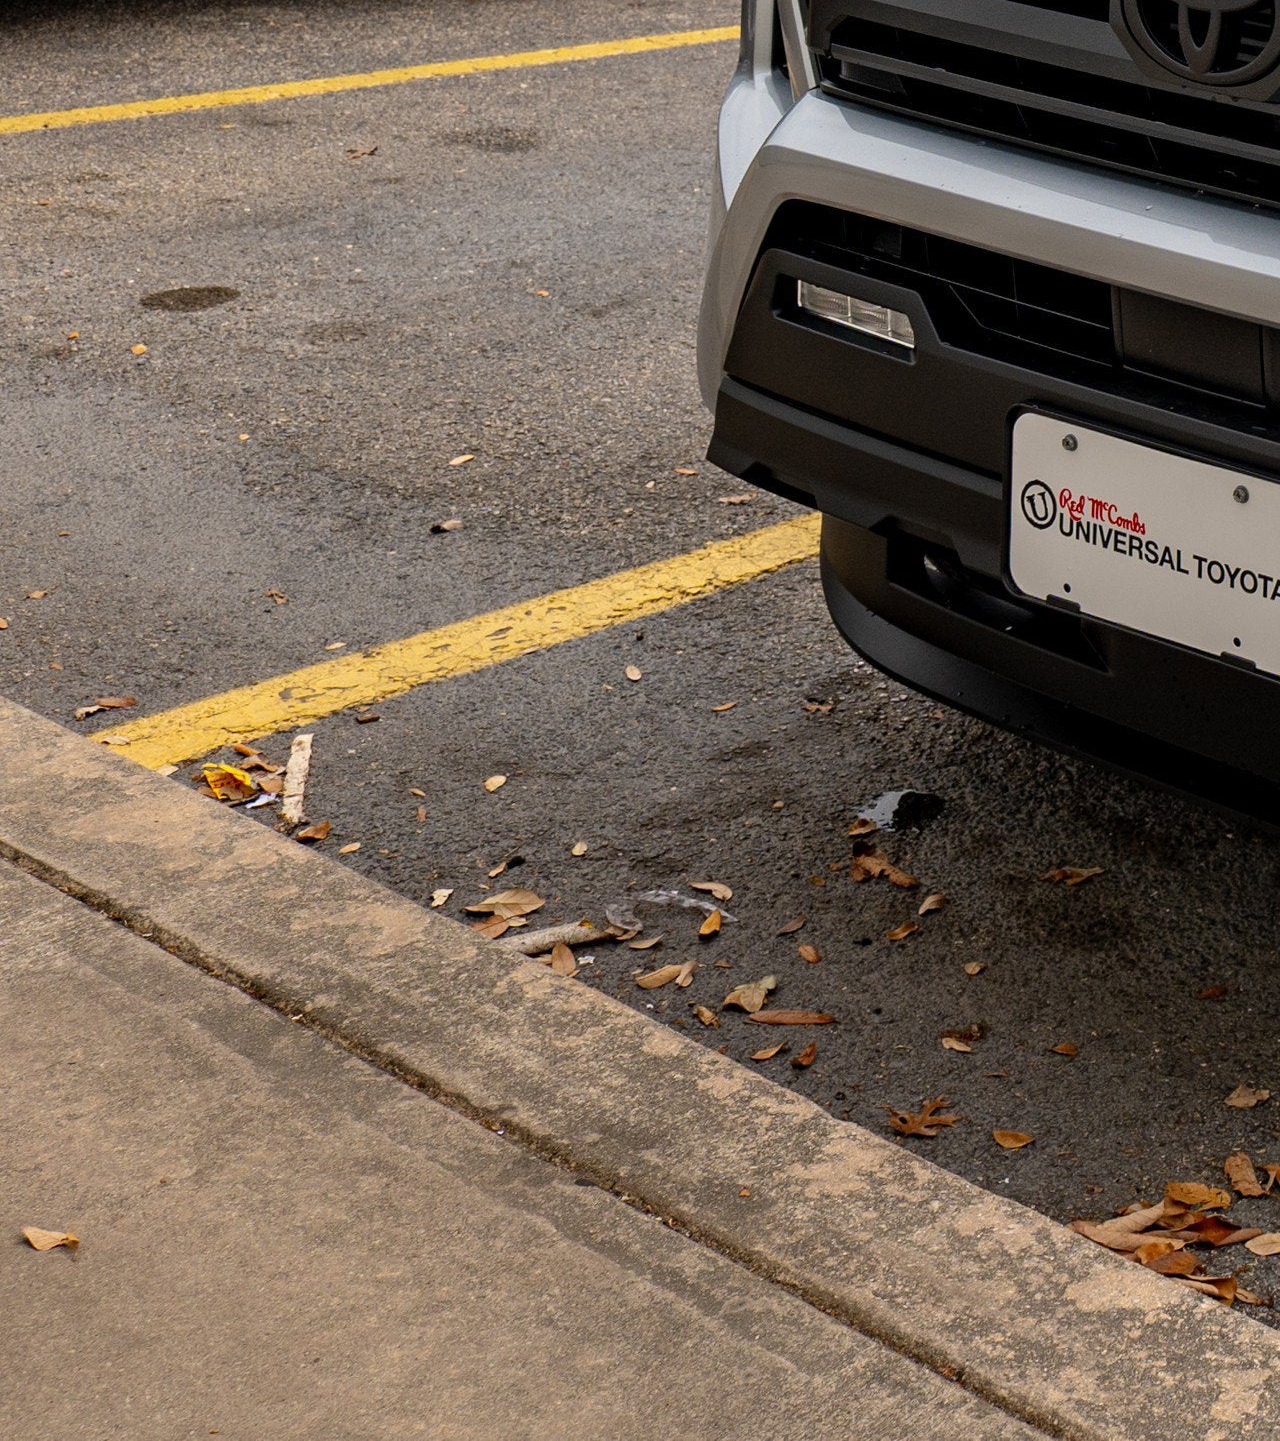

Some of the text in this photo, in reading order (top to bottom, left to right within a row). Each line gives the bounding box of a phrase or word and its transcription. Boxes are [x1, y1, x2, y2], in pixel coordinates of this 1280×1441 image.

[1059, 488, 1146, 536] Red McCombs
[1059, 512, 1190, 575] UNIVERSAL
